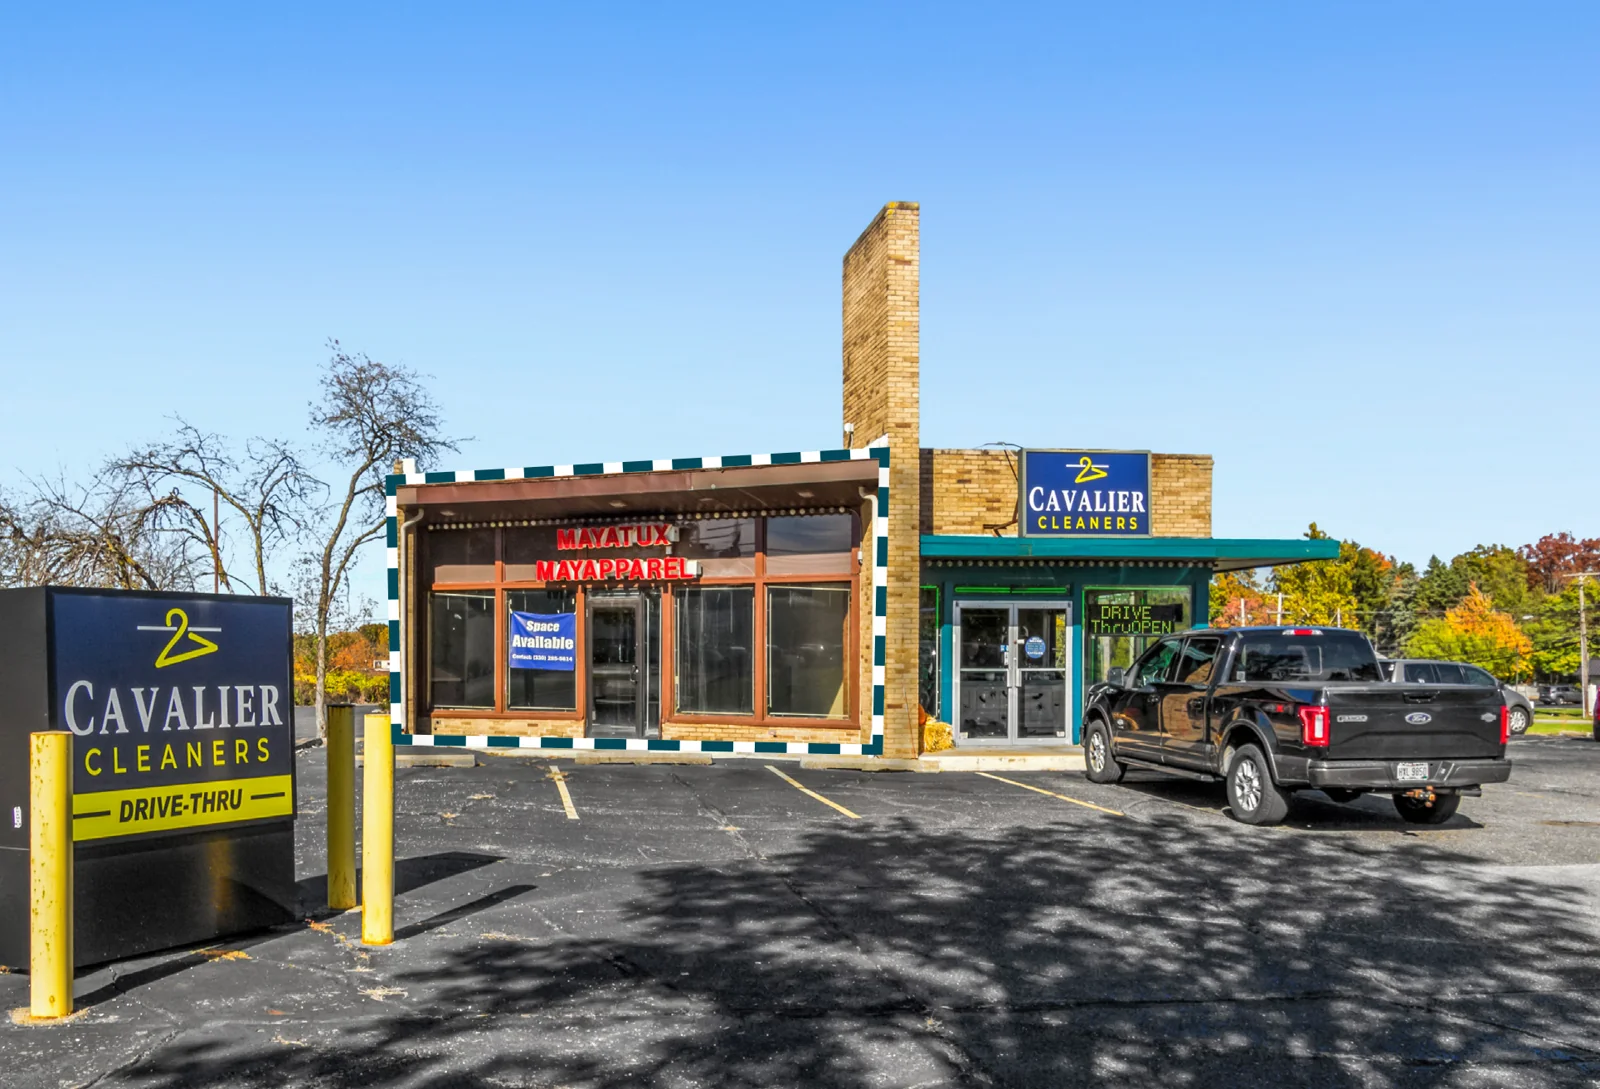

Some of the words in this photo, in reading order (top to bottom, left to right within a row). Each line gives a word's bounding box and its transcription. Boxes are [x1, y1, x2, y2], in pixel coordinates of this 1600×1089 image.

[1028, 486, 1146, 513] CAVALIER
[1037, 515, 1138, 530] CLEANERS
[556, 523, 672, 551] MAYATUX
[535, 556, 694, 582] MAYAPPAREL
[1101, 606, 1152, 619] DRIVE
[526, 620, 560, 632] Space
[511, 634, 574, 650] Available
[64, 679, 284, 737] CAVALIER
[84, 736, 271, 777] CLEANERS
[118, 787, 244, 823] DRIVE-THRU
